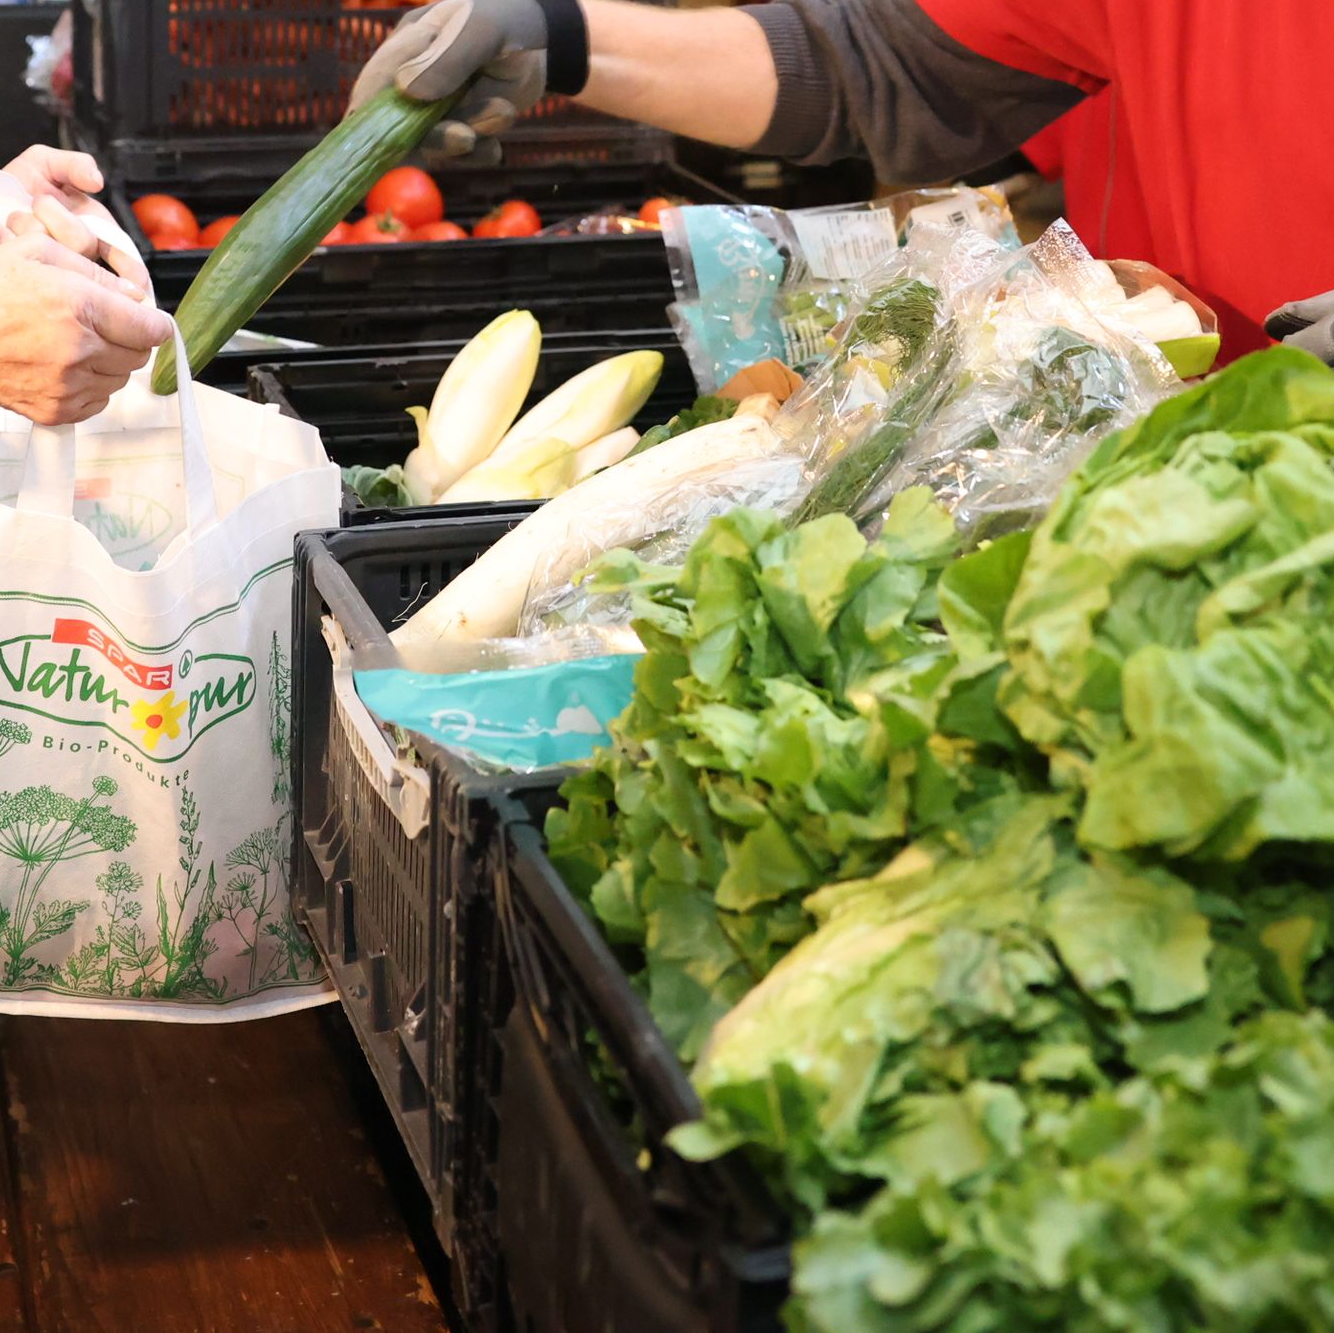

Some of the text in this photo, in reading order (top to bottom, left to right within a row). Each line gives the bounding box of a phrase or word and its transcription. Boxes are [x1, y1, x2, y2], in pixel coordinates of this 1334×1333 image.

[87, 628, 171, 686] SPAR
[188, 670, 253, 740] pur
[42, 735, 190, 789] Bio-Produkte
